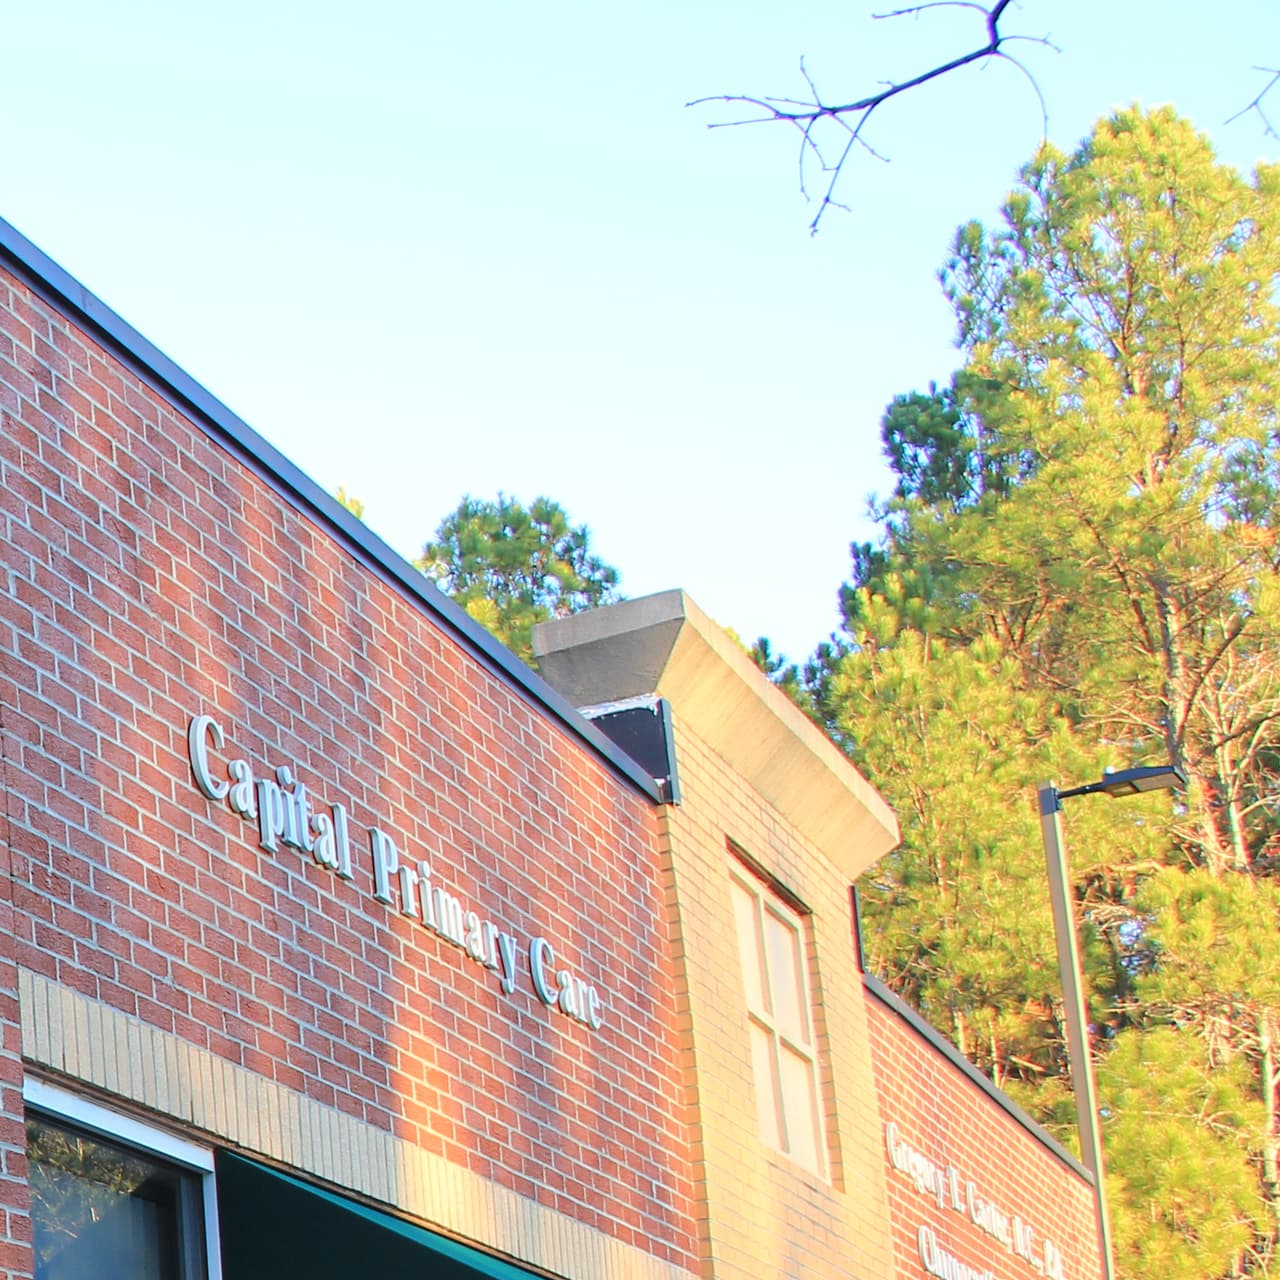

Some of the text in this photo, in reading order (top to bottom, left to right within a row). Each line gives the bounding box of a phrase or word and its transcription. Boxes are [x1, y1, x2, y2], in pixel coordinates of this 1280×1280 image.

[188, 714, 603, 1031] Capital Primary Care
[886, 1122, 944, 1209] Gregory
